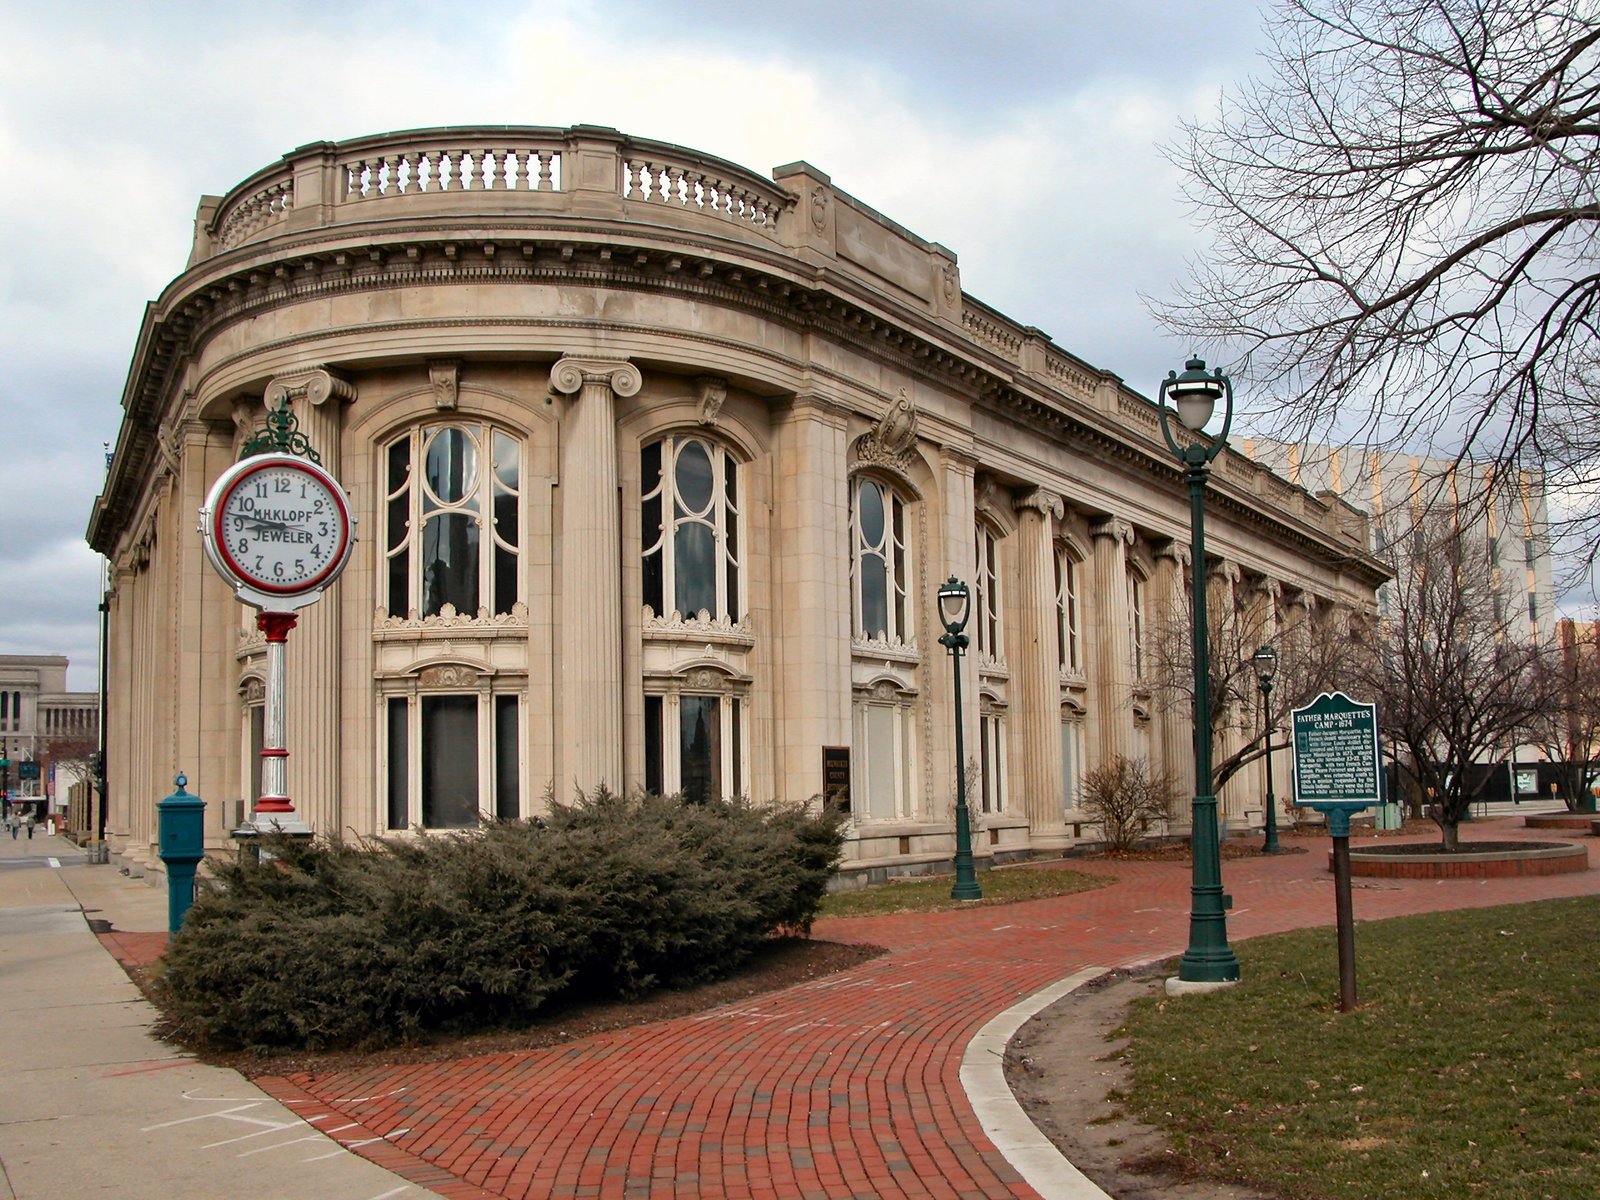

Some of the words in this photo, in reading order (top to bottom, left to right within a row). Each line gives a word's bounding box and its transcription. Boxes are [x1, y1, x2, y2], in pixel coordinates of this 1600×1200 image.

[255, 482, 268, 498] 11
[274, 477, 291, 493] 12
[301, 483, 307, 499] 1
[238, 496, 254, 512] 10
[313, 500, 324, 515] 2
[233, 518, 244, 533] 9
[317, 522, 328, 537] 3
[252, 530, 313, 544] JEWELER
[238, 538, 248, 554] 8
[310, 543, 321, 559] 4
[255, 555, 264, 570] 7
[274, 561, 284, 577] 6
[295, 559, 305, 575] 5
[1297, 714, 1322, 723] FATHER
[1314, 721, 1334, 729] CAMP
